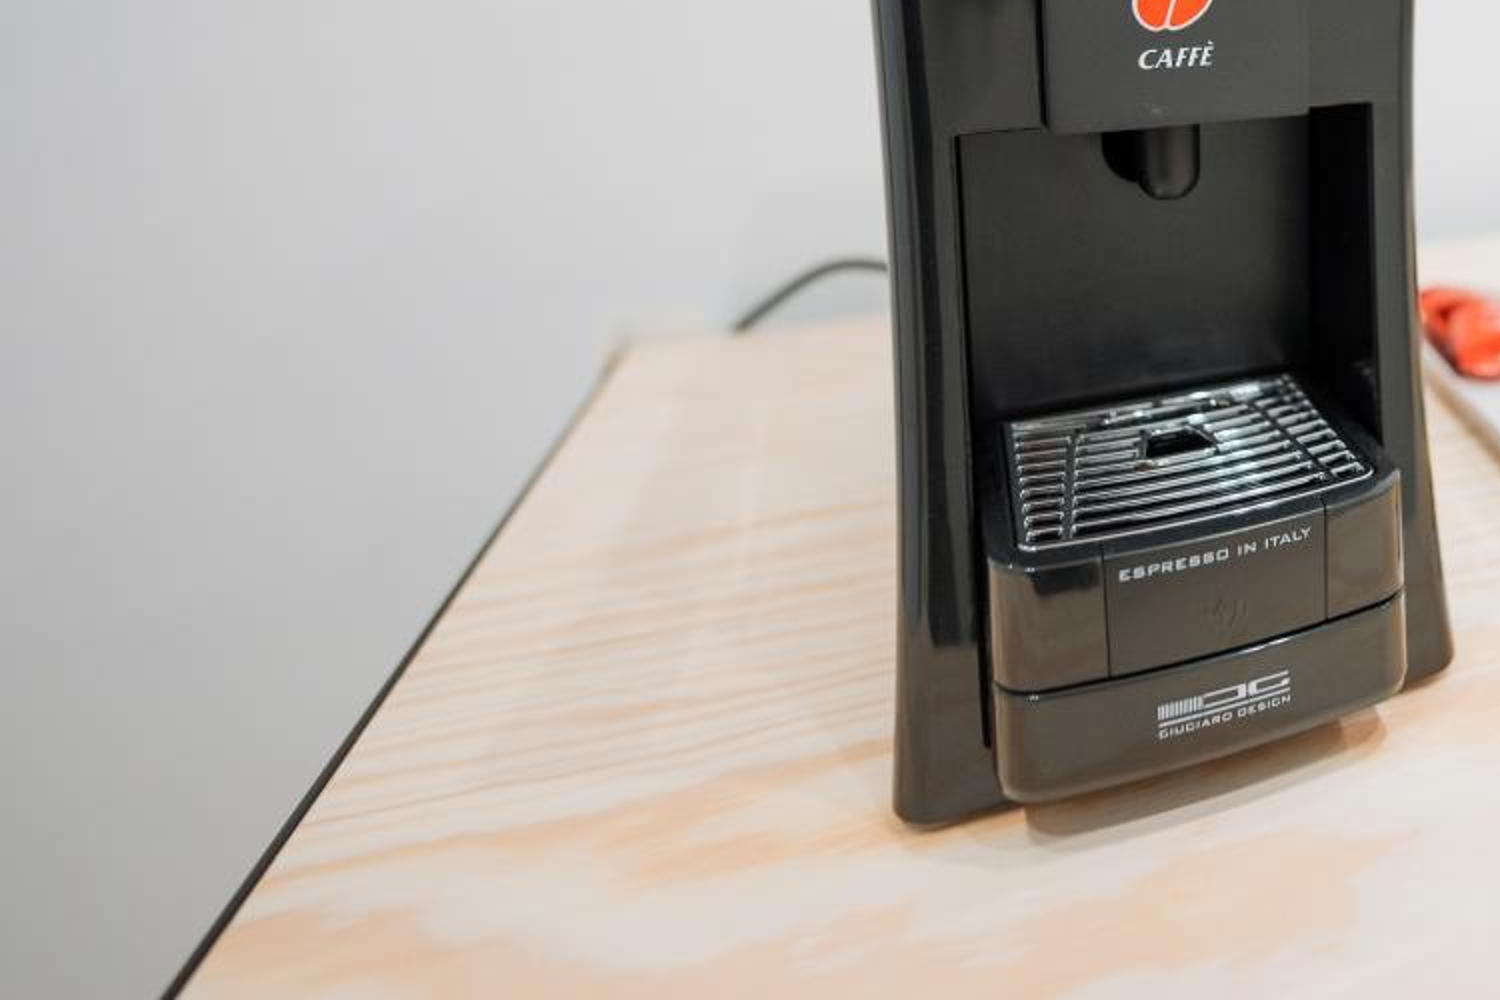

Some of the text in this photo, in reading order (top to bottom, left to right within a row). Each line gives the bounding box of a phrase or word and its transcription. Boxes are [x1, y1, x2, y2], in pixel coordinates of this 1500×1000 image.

[1138, 40, 1215, 70] CAFFÈ
[1118, 526, 1312, 582] ESPRESSO IN ITALY
[1237, 694, 1291, 718] DESIGN
